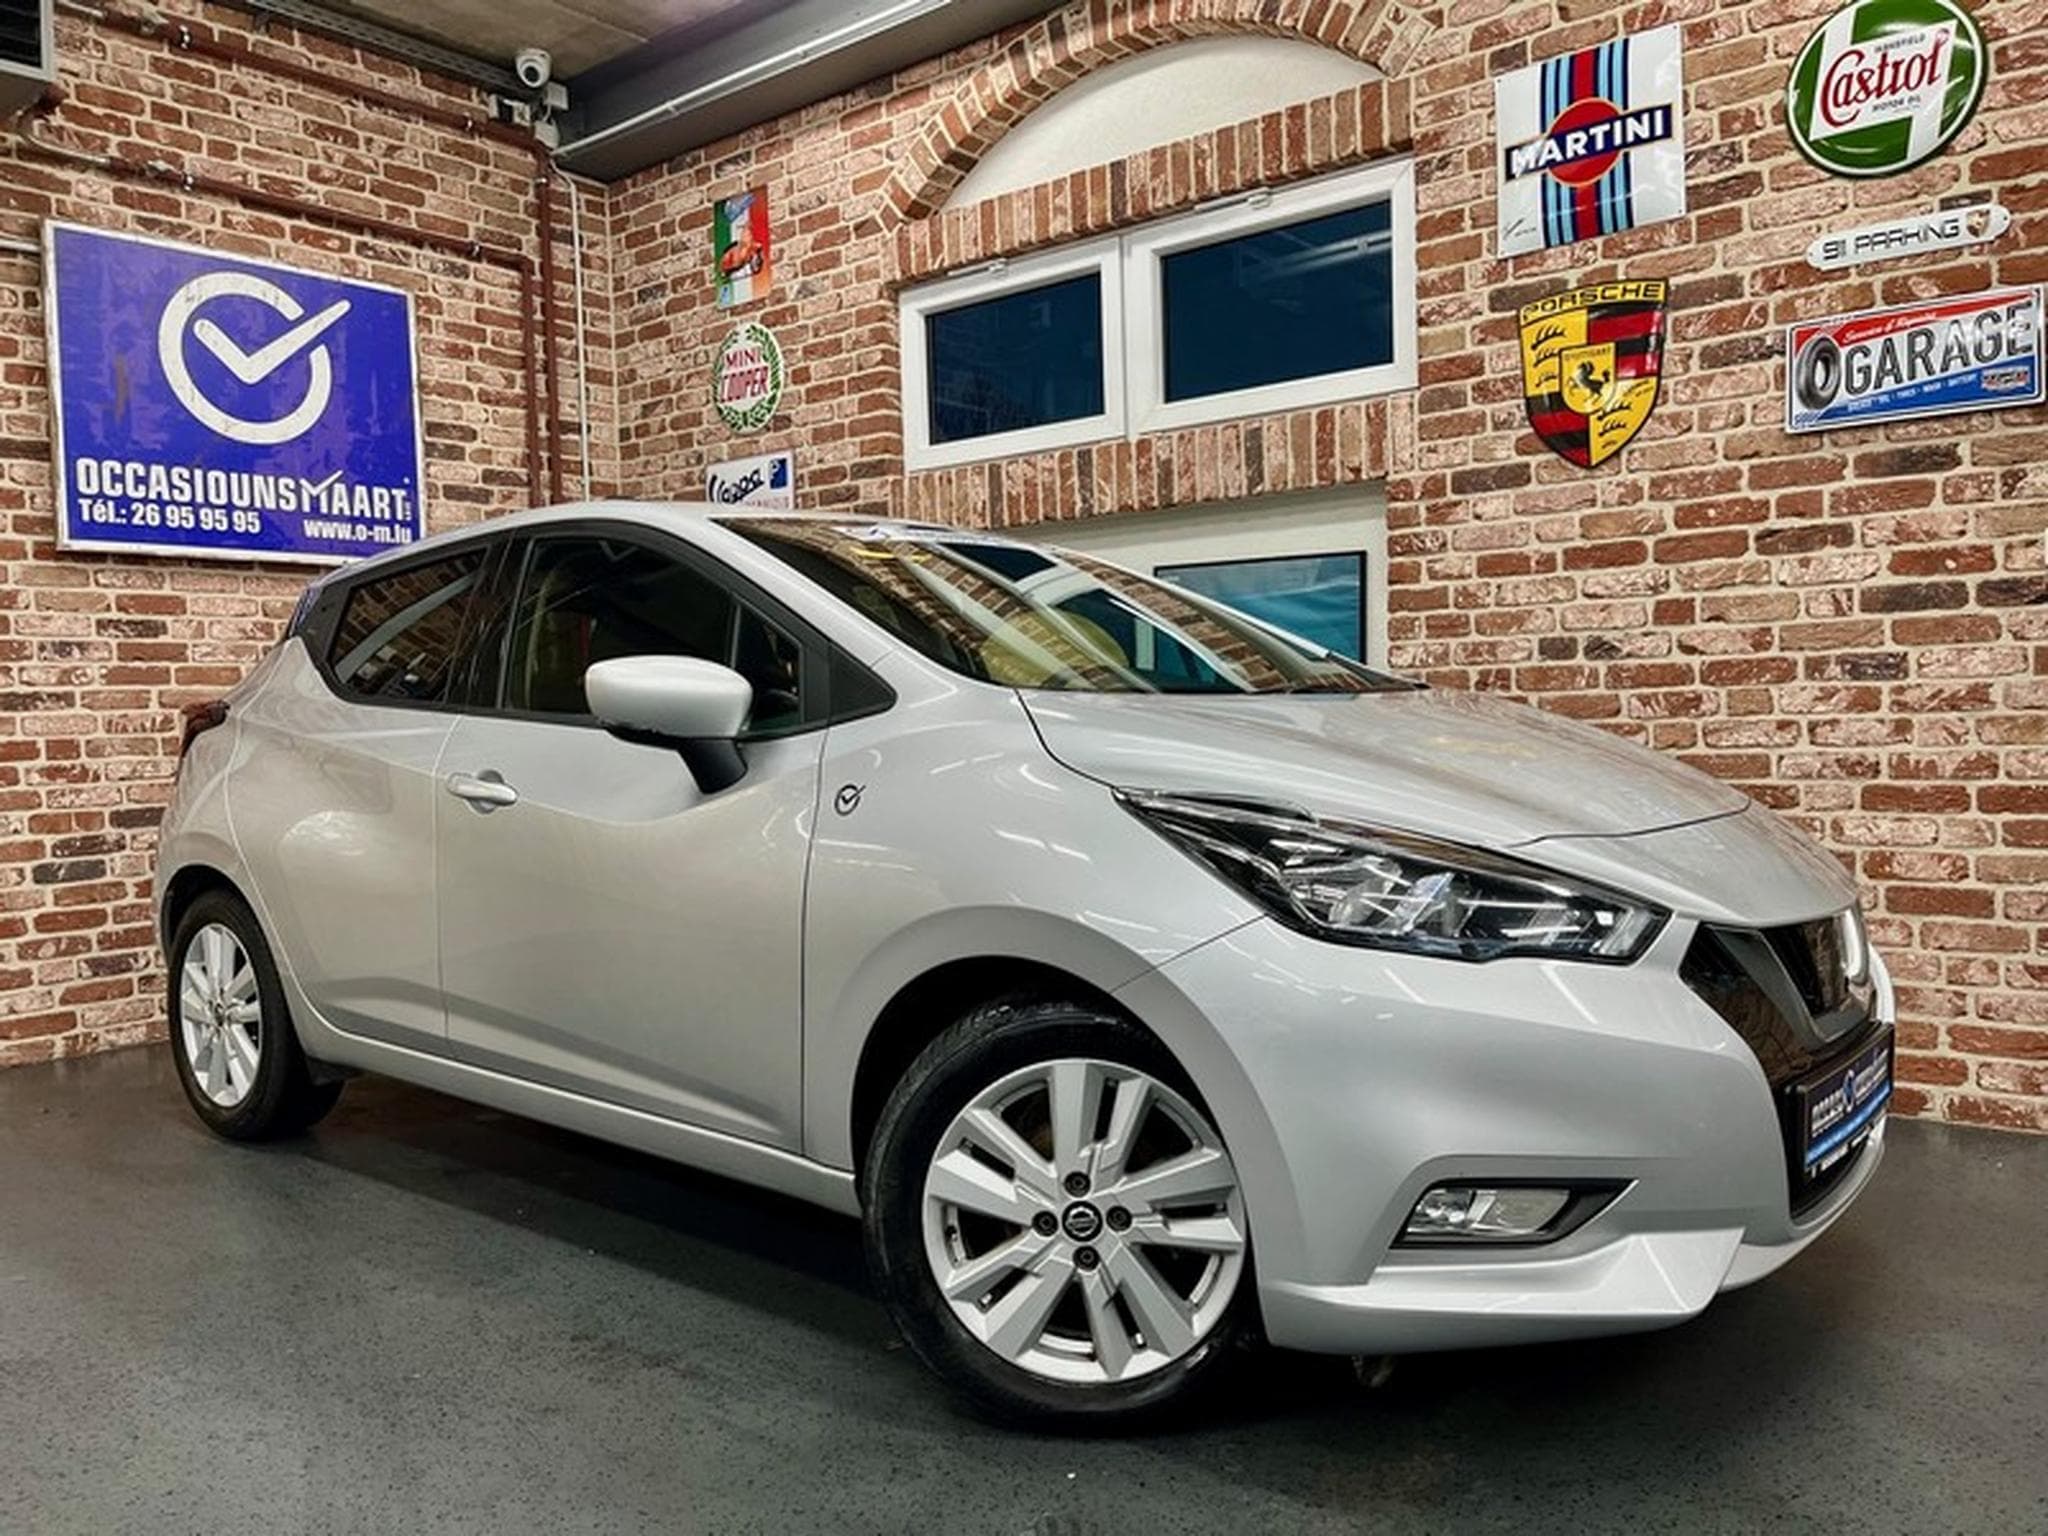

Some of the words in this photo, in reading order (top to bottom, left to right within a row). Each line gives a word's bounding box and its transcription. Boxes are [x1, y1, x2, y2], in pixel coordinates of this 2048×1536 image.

[1820, 28, 1950, 128] Castrol
[1510, 109, 1664, 178] MARTINI
[1855, 218, 1960, 254] PARKING
[1522, 283, 1662, 321] PORSCHE
[725, 345, 762, 369] MINI
[1844, 302, 2034, 396] GARAGE
[720, 366, 770, 403] COOPER
[708, 468, 766, 504] Vespa
[130, 501, 161, 526] 26
[165, 504, 195, 529] 95
[199, 507, 229, 532] 95
[232, 509, 262, 534] 95
[303, 519, 412, 545] www.o-m.lu
